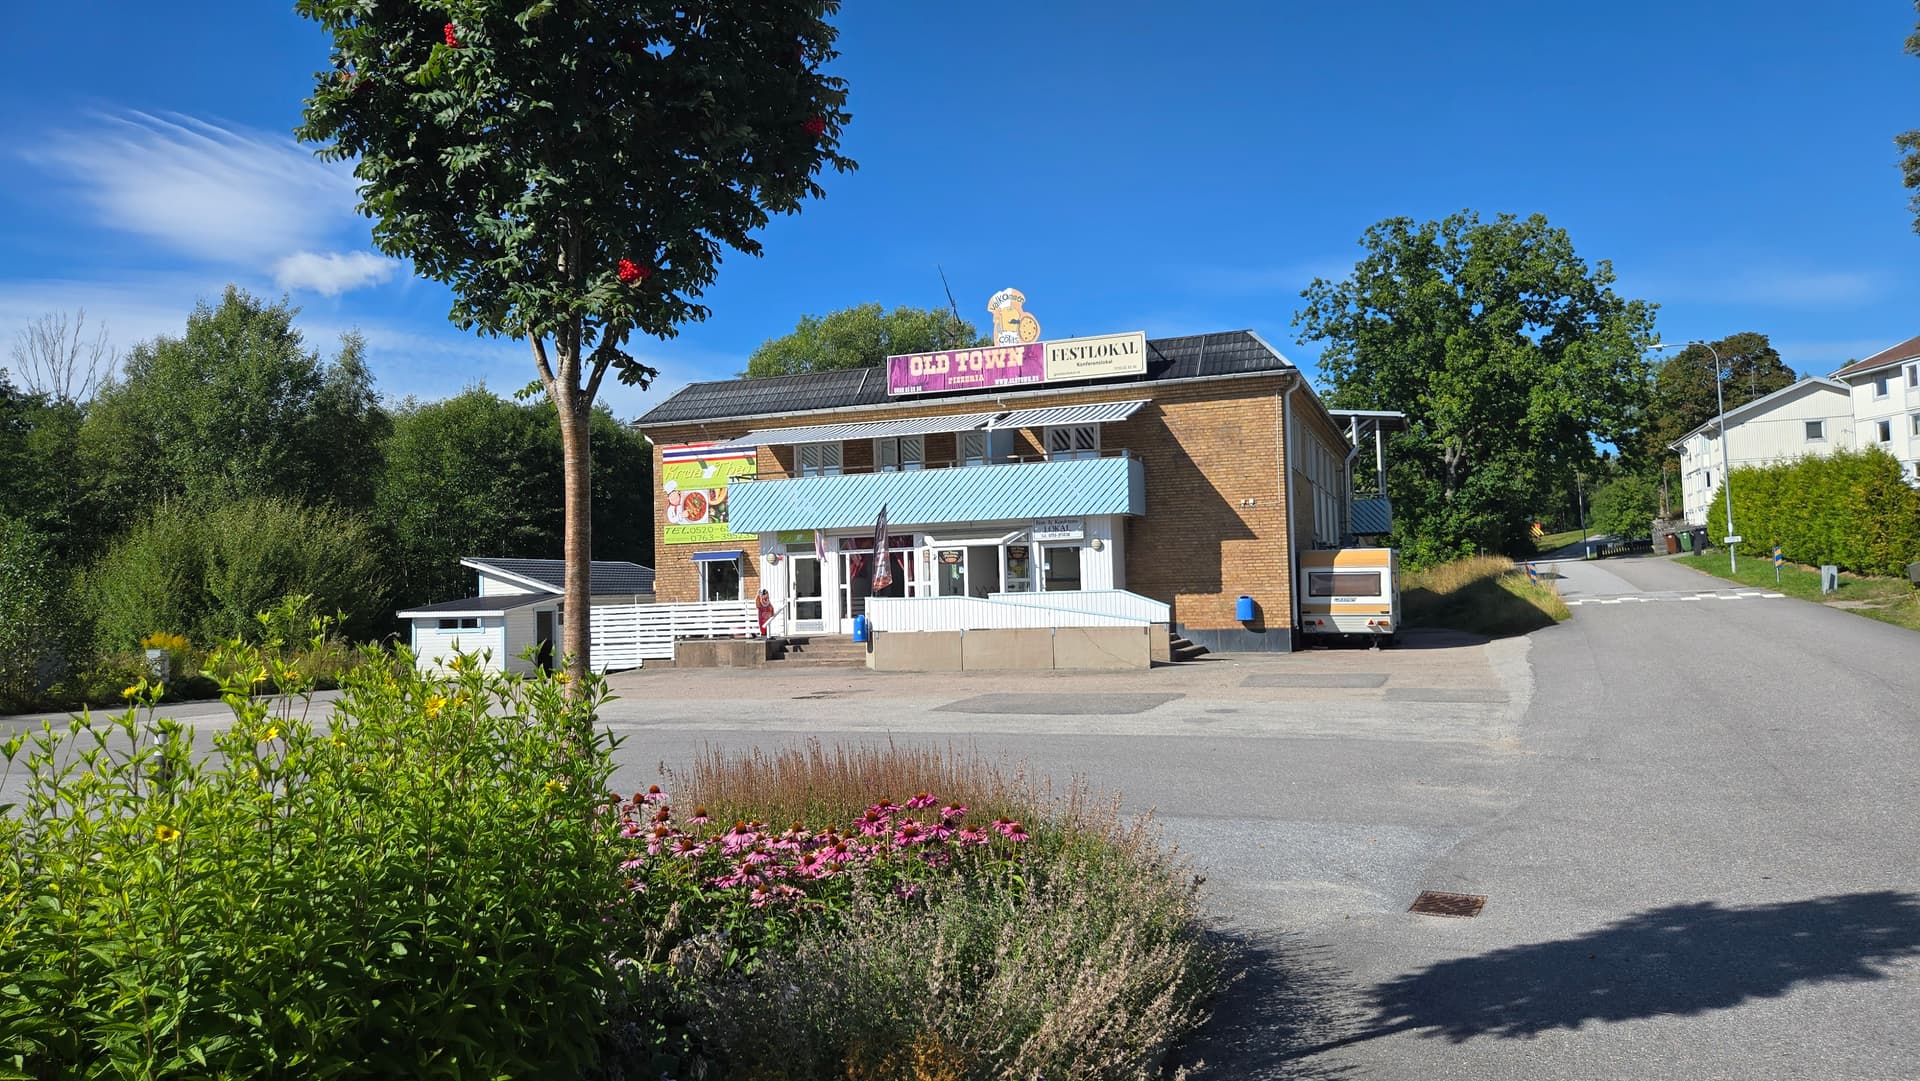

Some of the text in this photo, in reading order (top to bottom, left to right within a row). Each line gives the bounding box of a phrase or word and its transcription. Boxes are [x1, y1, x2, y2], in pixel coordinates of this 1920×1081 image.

[910, 346, 1024, 376] OLD TOWN
[1052, 341, 1138, 361] FESTLOKAL
[1043, 524, 1072, 532] LOKAL
